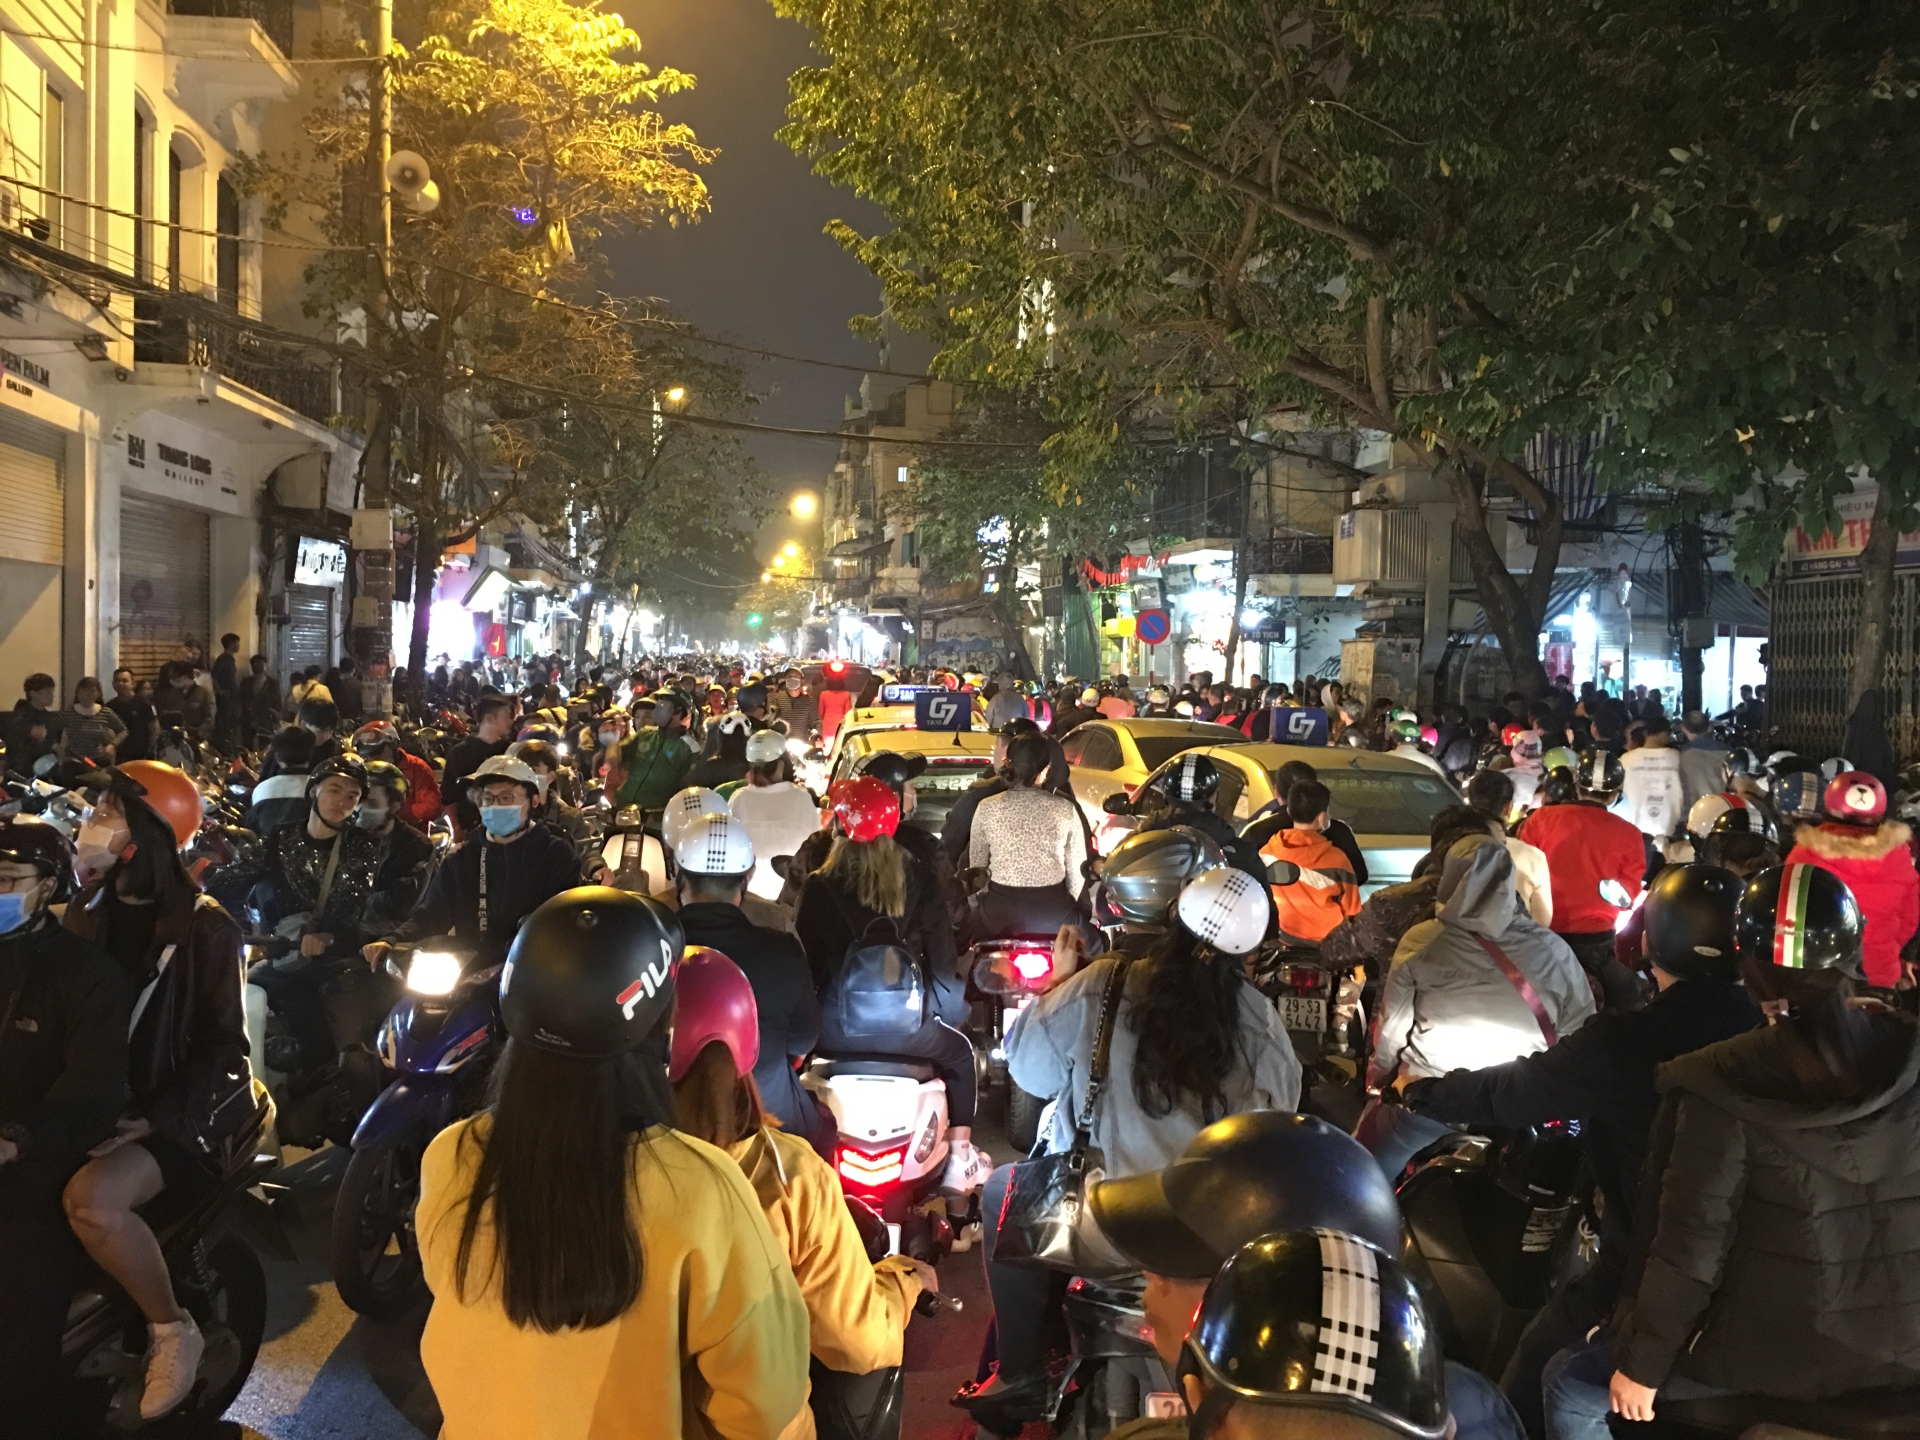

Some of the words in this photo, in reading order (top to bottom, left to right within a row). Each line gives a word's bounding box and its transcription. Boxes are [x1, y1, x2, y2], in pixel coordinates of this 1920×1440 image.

[23, 358, 50, 388] PALM
[6, 378, 33, 398] GALLERY
[164, 468, 204, 487] GALLERY
[900, 689, 915, 701] SAO
[928, 696, 958, 726] G7
[926, 719, 941, 727] TAXI
[1288, 711, 1316, 740] G7
[616, 938, 673, 1021] FILA
[1285, 1013, 1320, 1030] 5442
[964, 1160, 979, 1180] NEW
